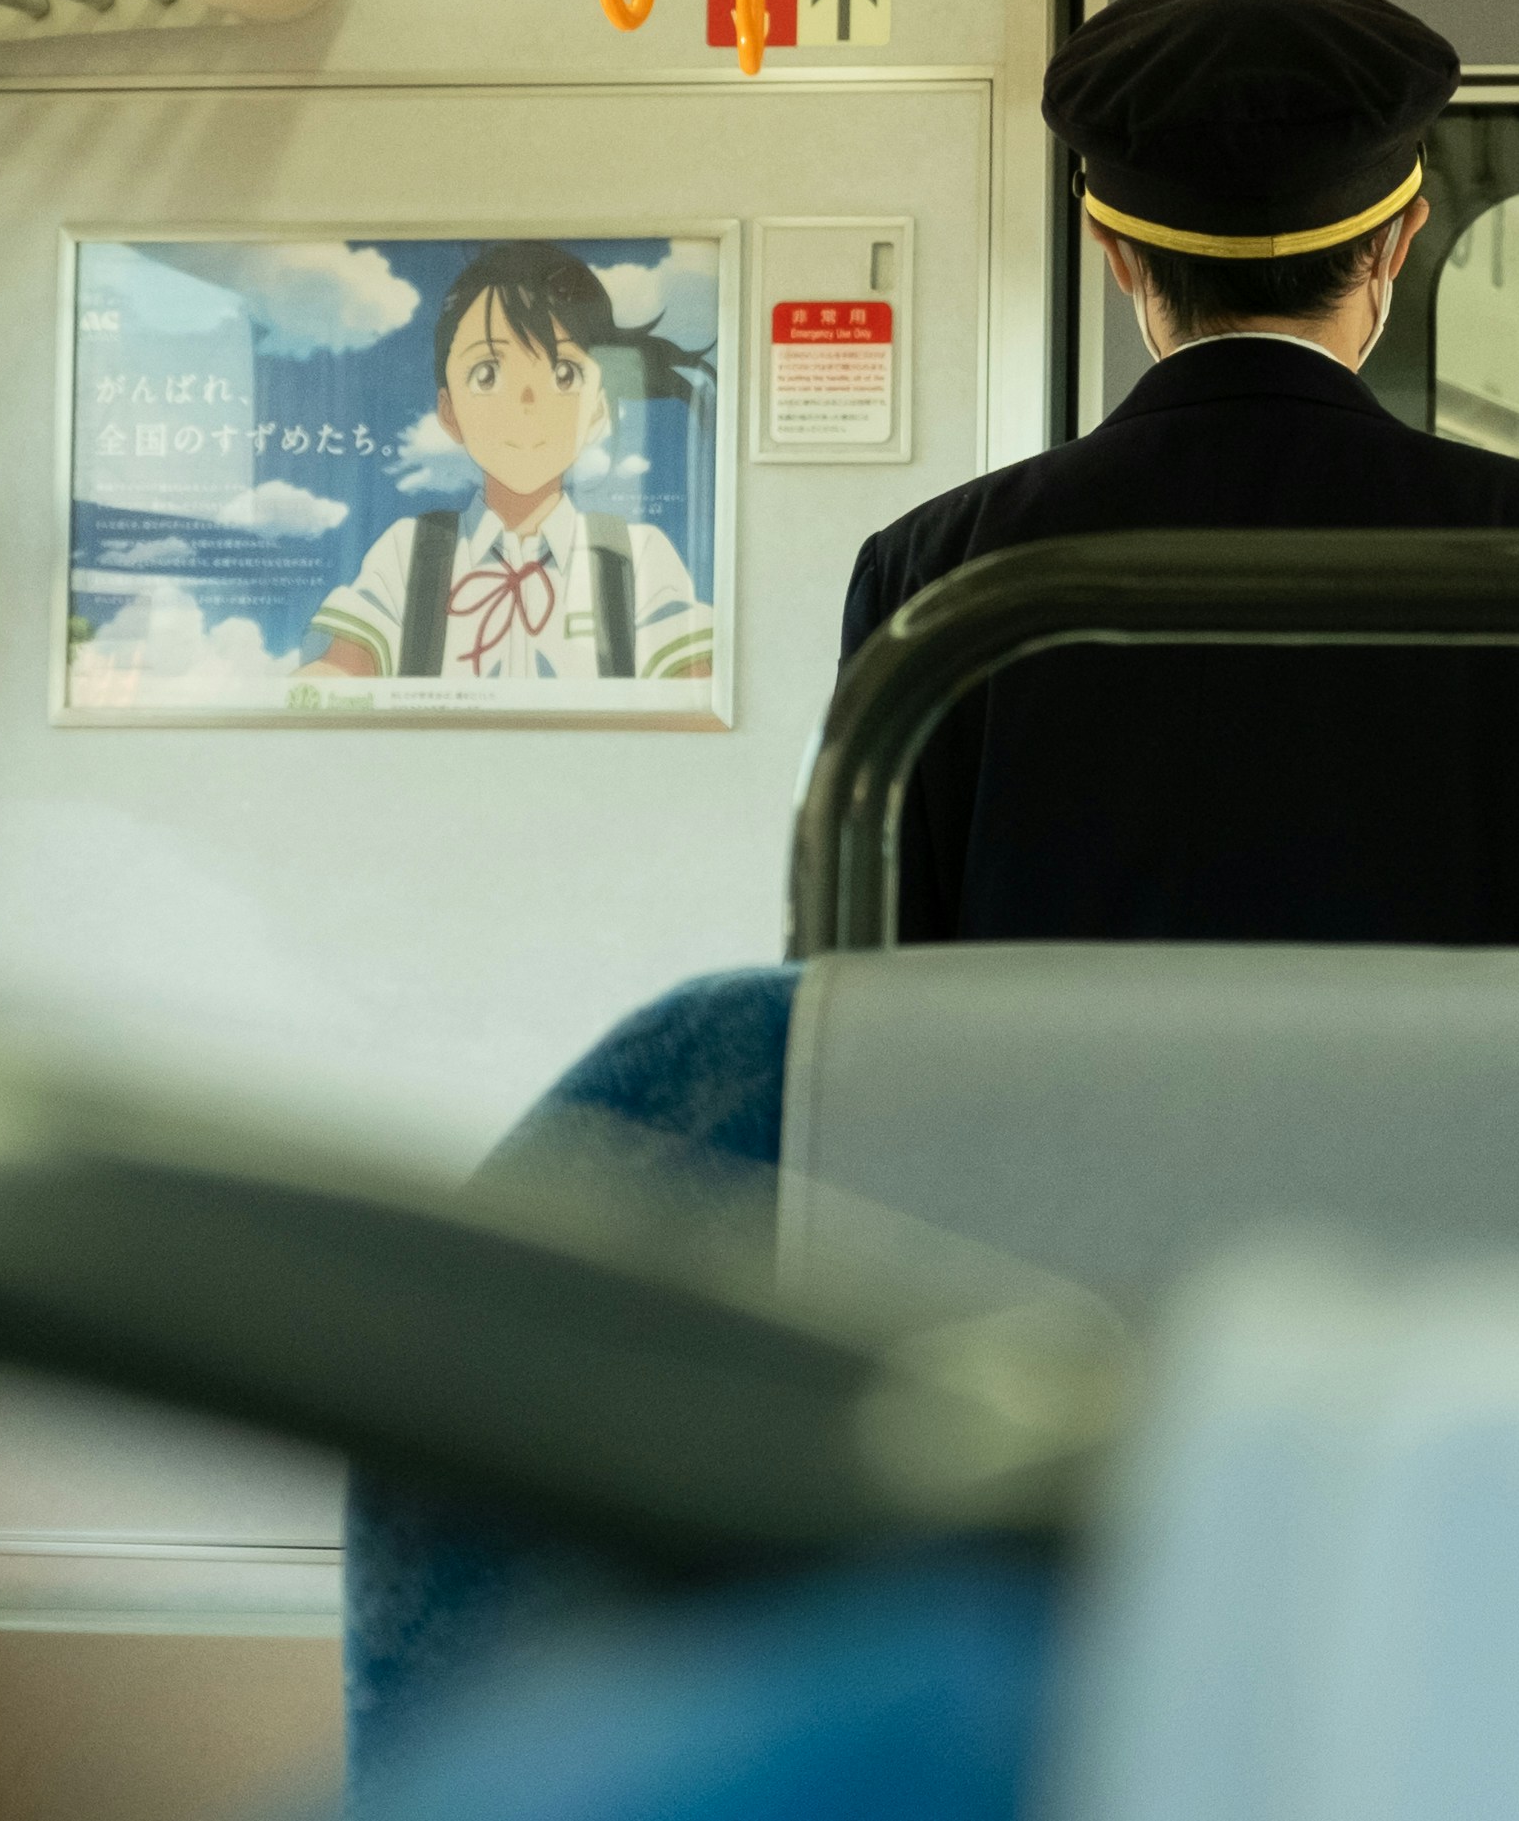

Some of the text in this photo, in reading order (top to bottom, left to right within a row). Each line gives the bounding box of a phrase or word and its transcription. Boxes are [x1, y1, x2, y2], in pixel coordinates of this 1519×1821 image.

[792, 308, 867, 325] 非常用
[791, 327, 872, 340] Emergency Use Only
[96, 374, 251, 406] がんばれ、
[96, 421, 392, 457] 全国のすずめたち。
